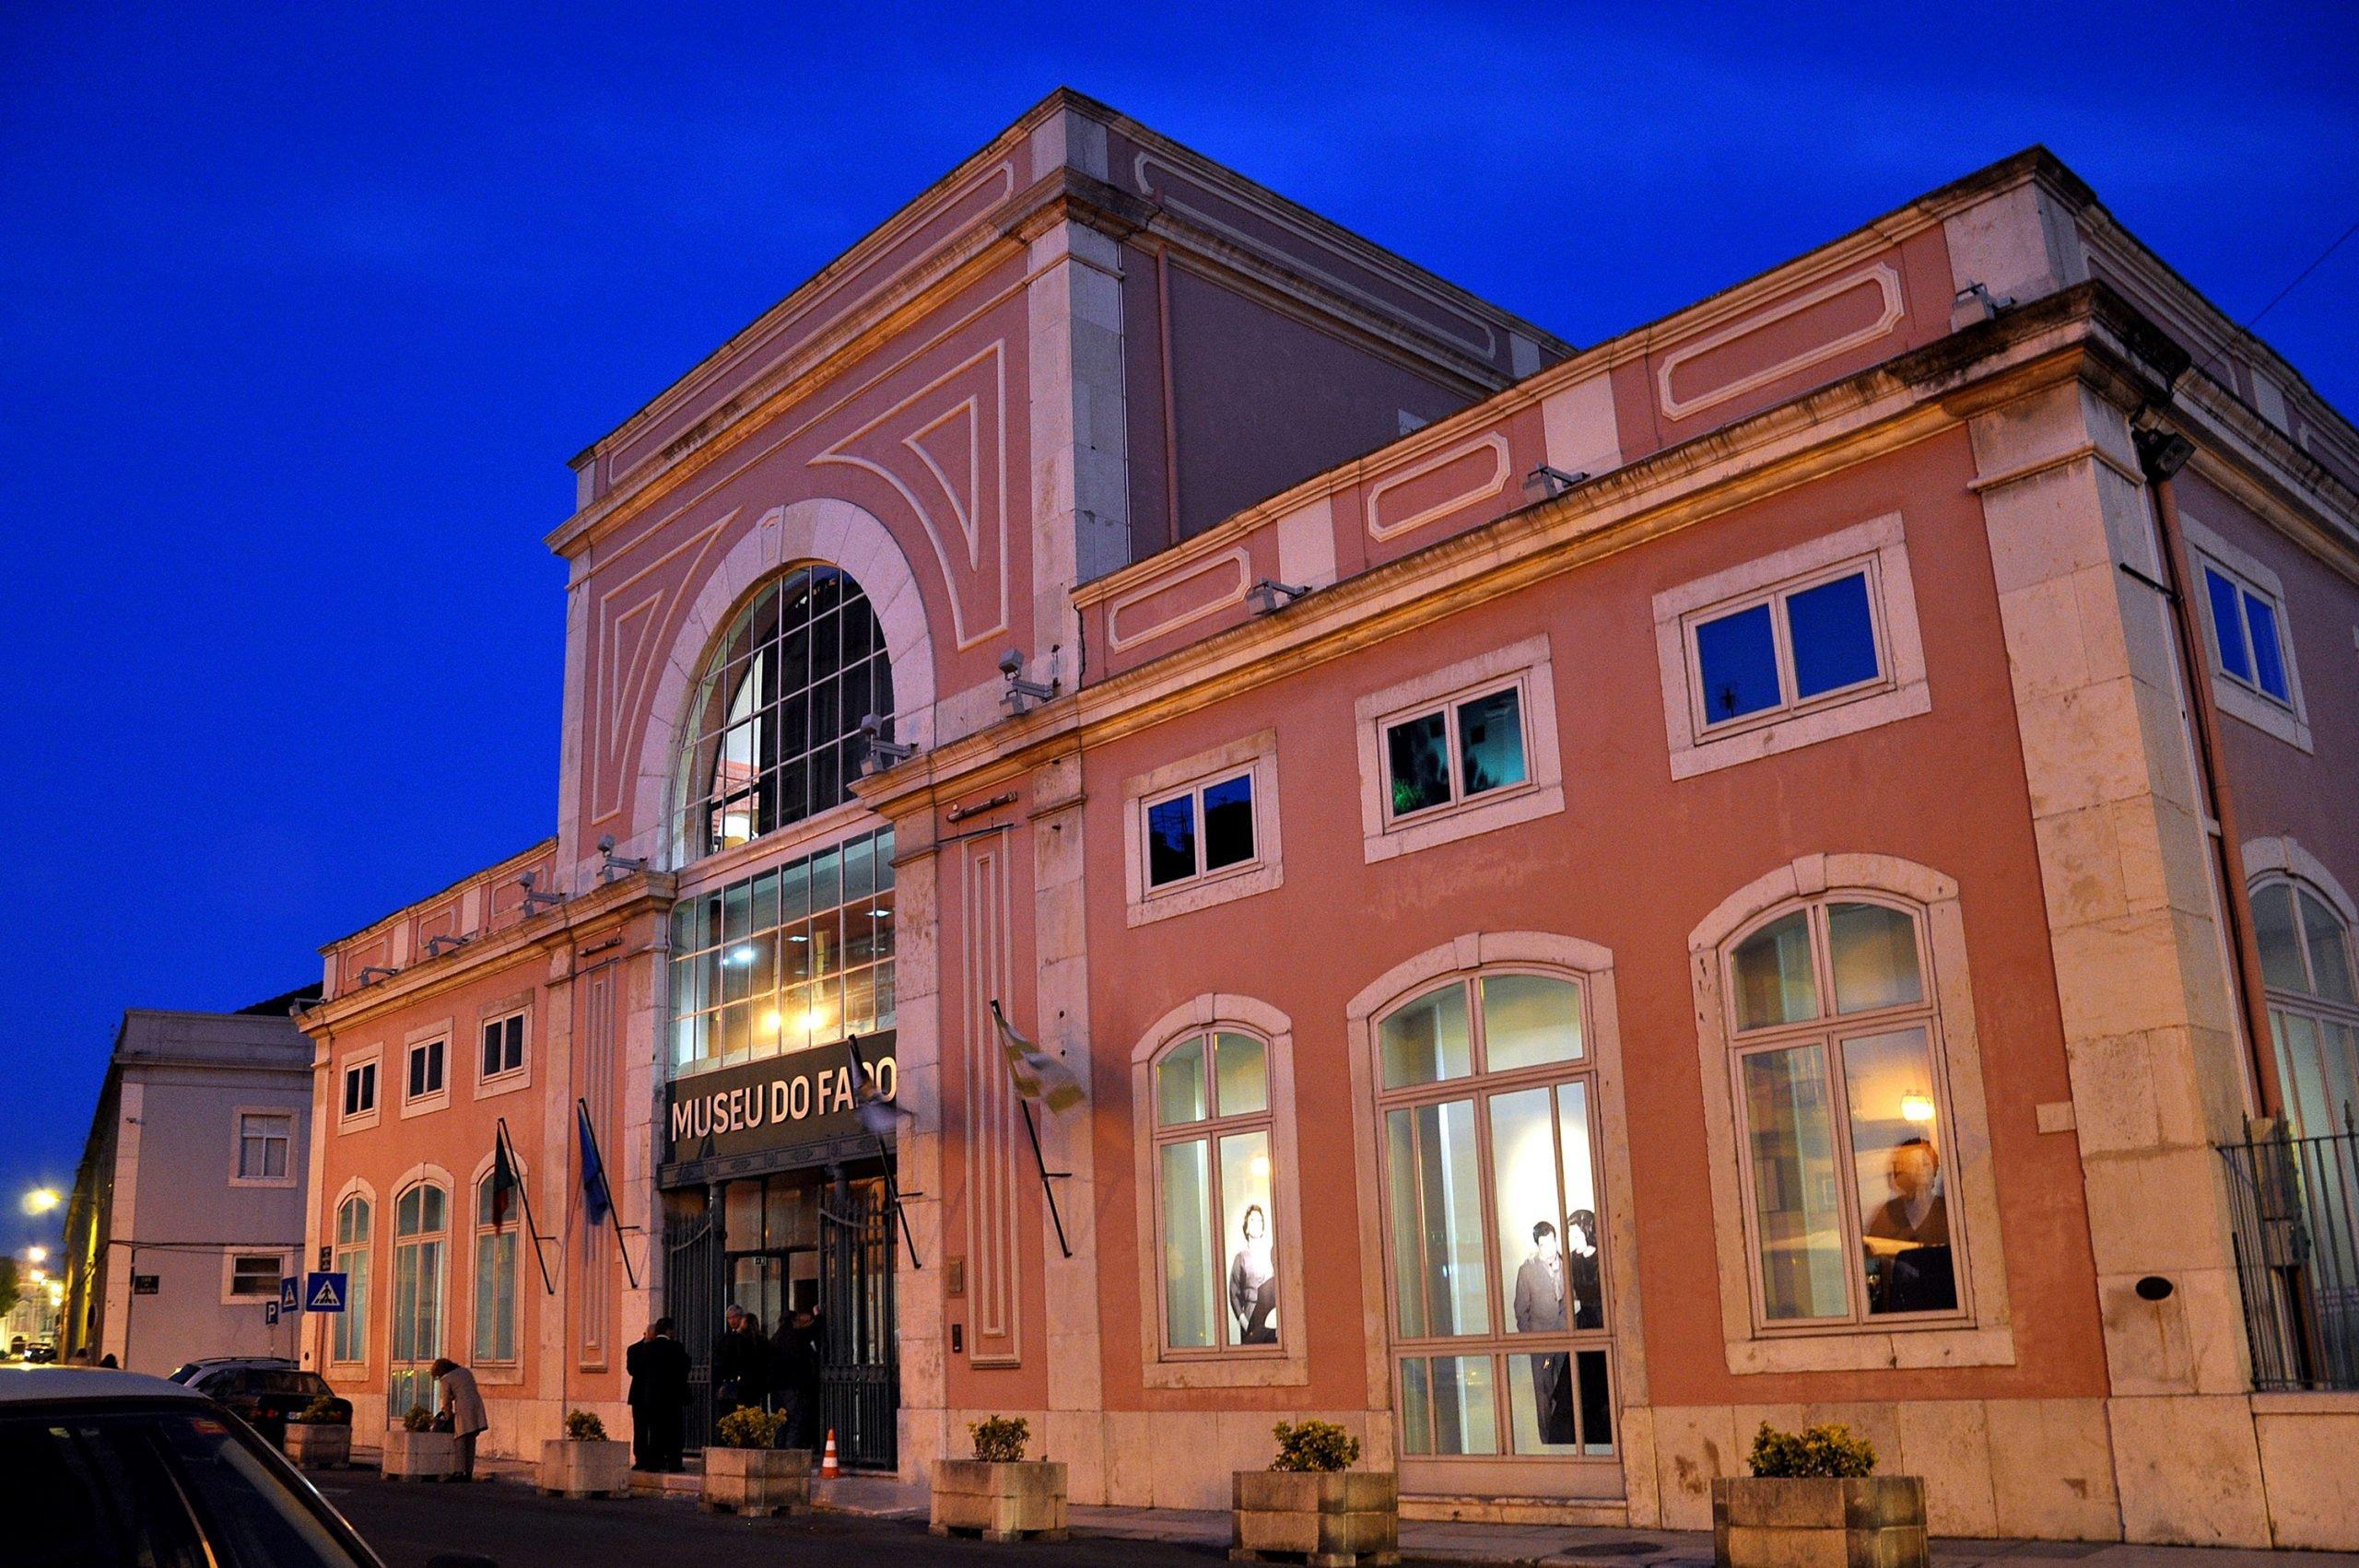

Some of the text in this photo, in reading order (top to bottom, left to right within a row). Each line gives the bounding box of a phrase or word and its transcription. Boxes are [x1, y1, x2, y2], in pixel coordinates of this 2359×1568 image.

[672, 1083, 763, 1142] MUSEU
[771, 1075, 810, 1124] DO
[268, 1305, 276, 1322] P
